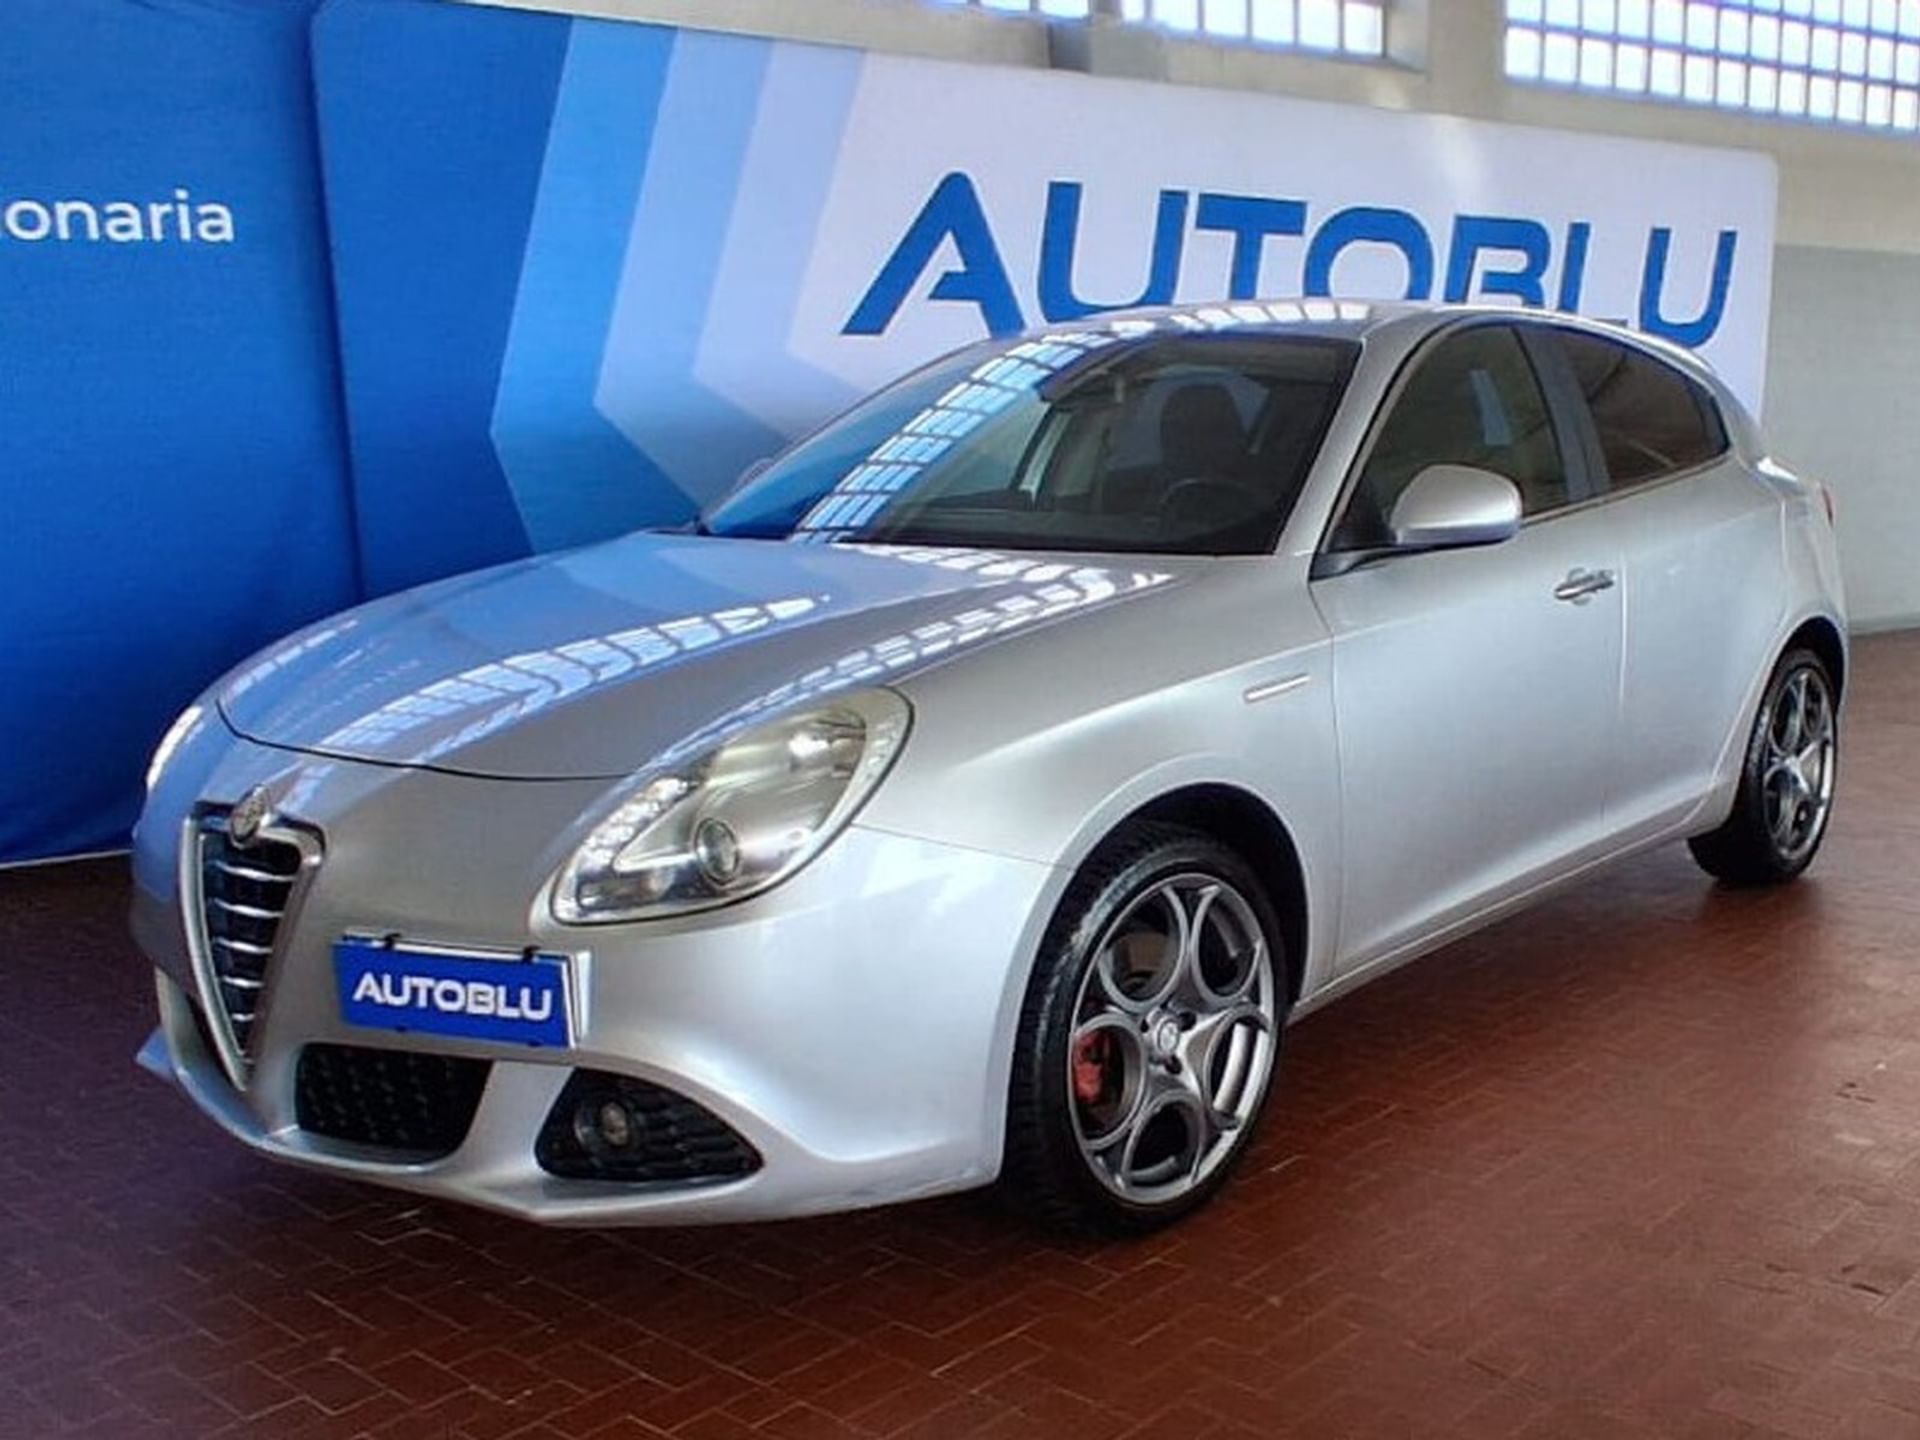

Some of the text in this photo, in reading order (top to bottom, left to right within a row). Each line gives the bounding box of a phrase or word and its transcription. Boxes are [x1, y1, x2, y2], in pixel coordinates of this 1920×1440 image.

[4, 188, 235, 242] onaria
[841, 172, 1738, 349] AUTOBLU
[352, 971, 551, 1021] AUTOBLU
